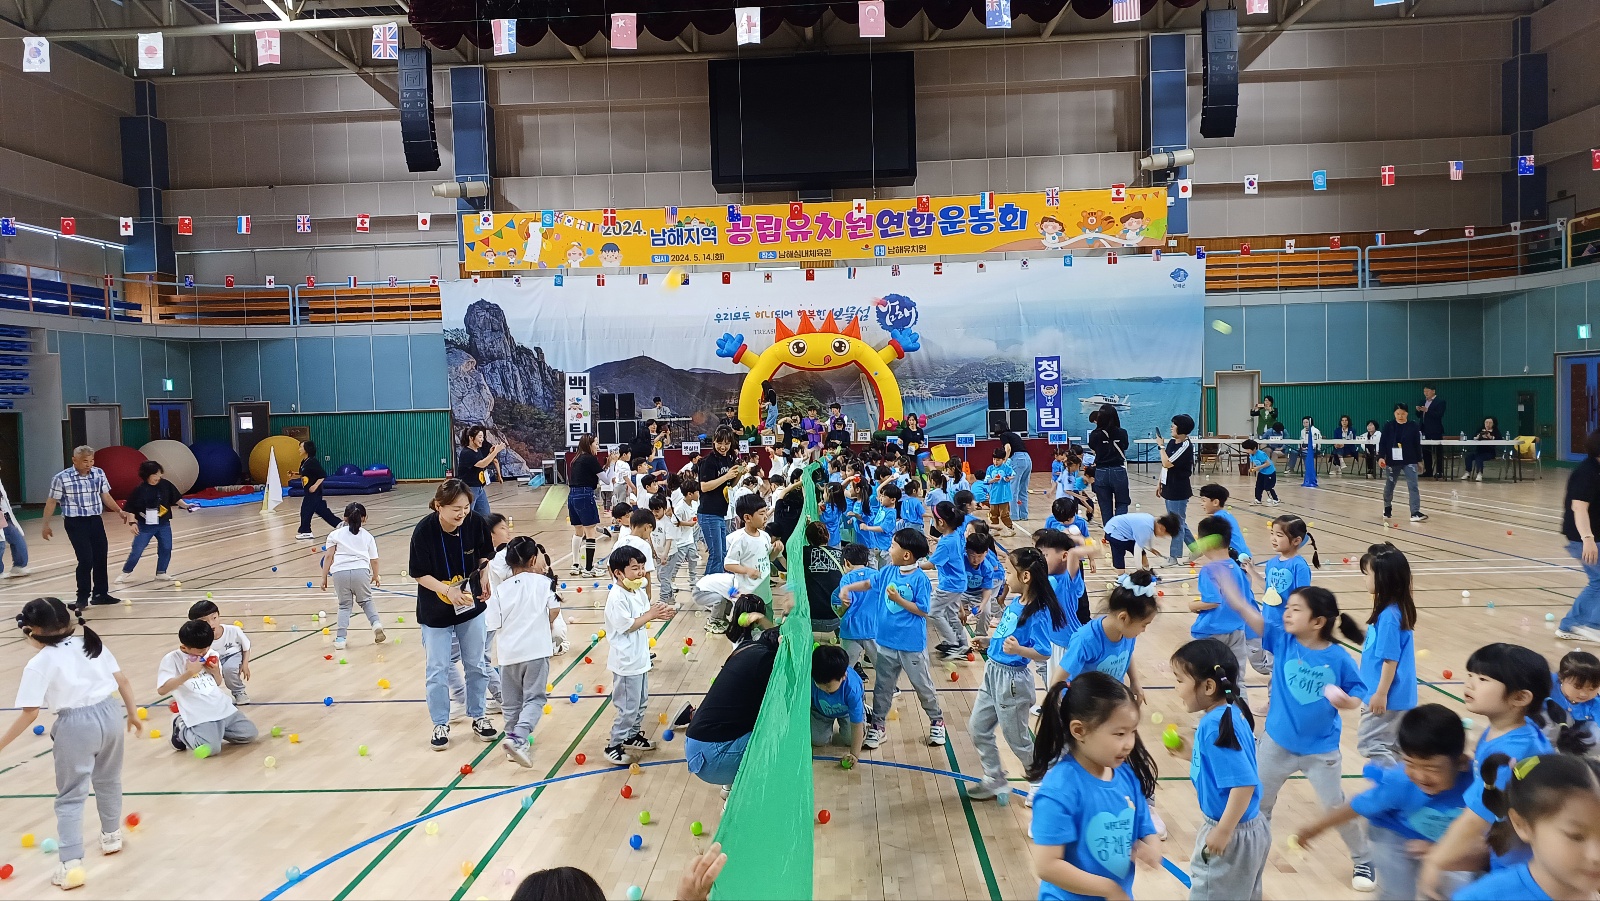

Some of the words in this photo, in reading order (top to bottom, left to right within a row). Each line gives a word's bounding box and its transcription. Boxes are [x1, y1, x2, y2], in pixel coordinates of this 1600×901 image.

[650, 226, 718, 247] 남해지역
[778, 248, 832, 259] 남해실내체육관
[887, 244, 927, 255] 남해유치원
[670, 254, 692, 262] 2024.
[693, 253, 701, 262] 5.
[714, 311, 751, 324] 우리모두
[755, 309, 793, 319] 하나되어
